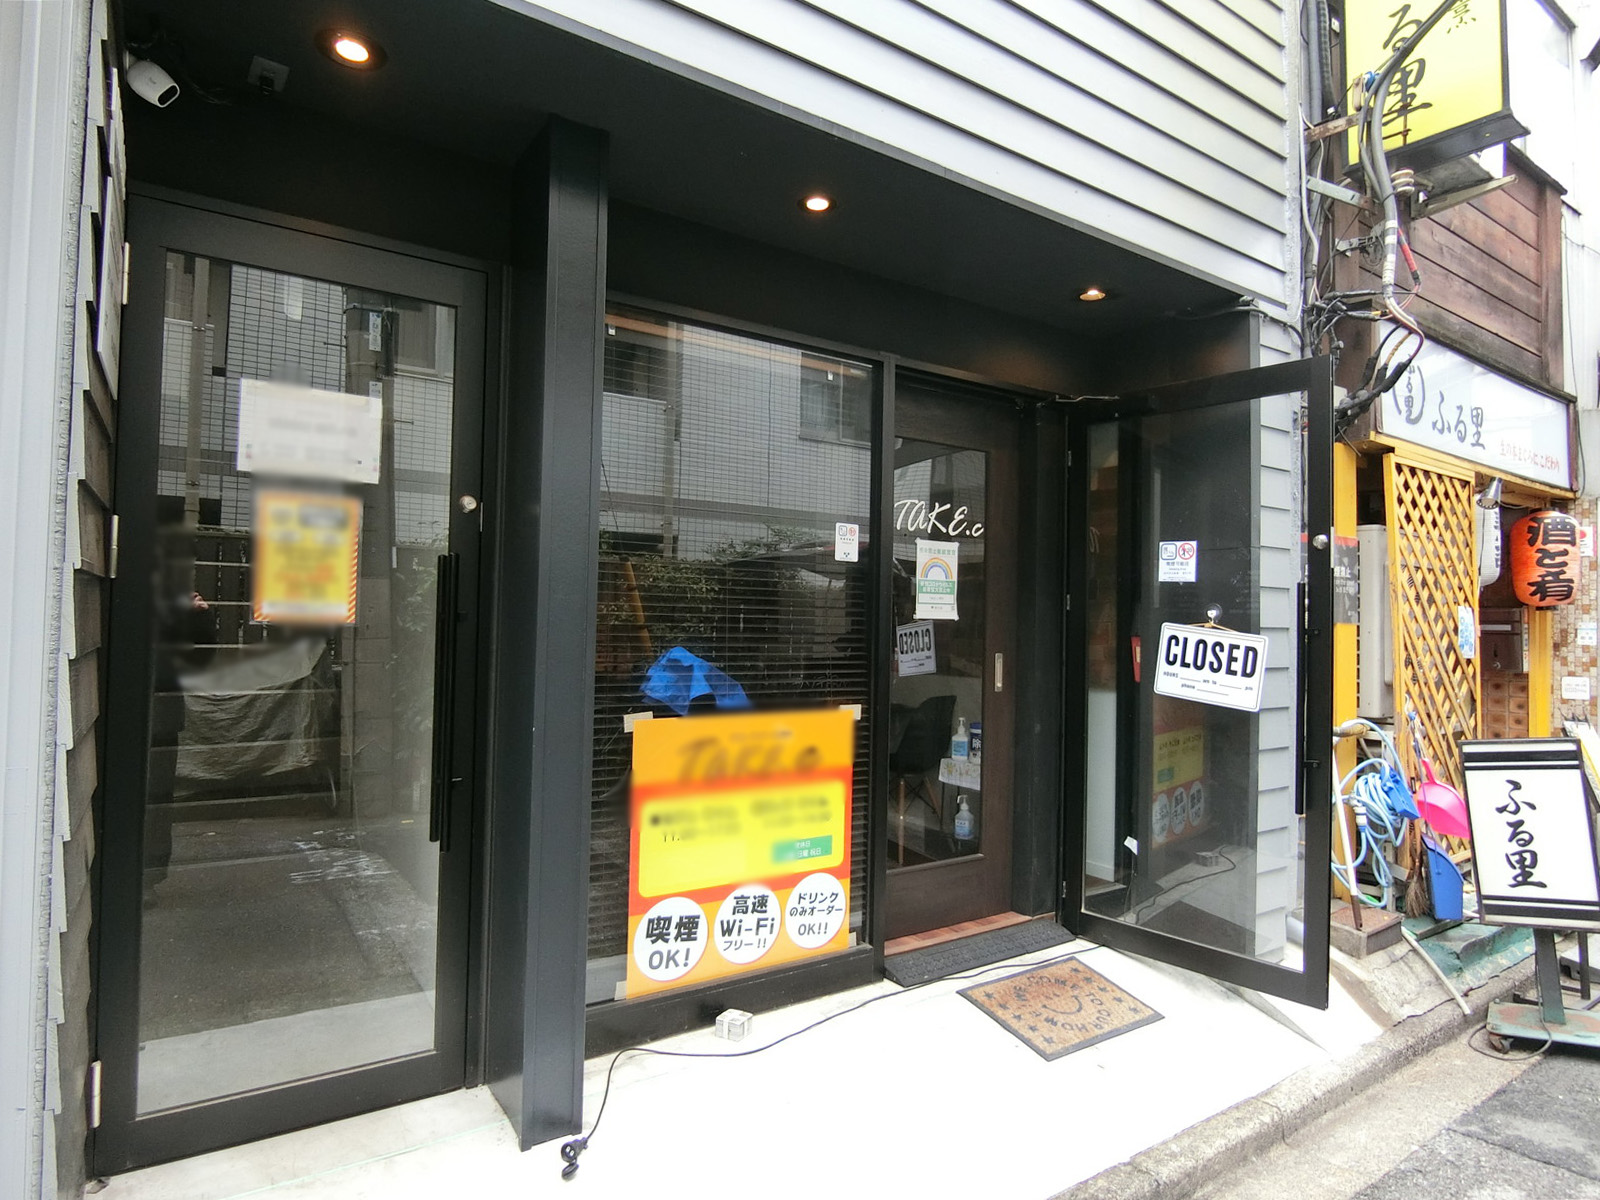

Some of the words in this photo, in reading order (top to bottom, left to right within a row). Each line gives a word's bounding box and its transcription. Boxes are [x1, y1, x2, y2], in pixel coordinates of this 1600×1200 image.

[1432, 390, 1485, 449] ふる里
[1526, 516, 1577, 602] 酒と肴
[1165, 635, 1258, 678] CLOSED
[1495, 779, 1548, 889] ふる里
[732, 894, 769, 916] 高速
[797, 892, 839, 905] ドリンク
[789, 905, 843, 917] のみオーダー
[645, 915, 701, 945] 喫煙
[720, 917, 776, 938] Wi-Fi
[797, 922, 828, 936] OK!!
[648, 947, 691, 971] OK!
